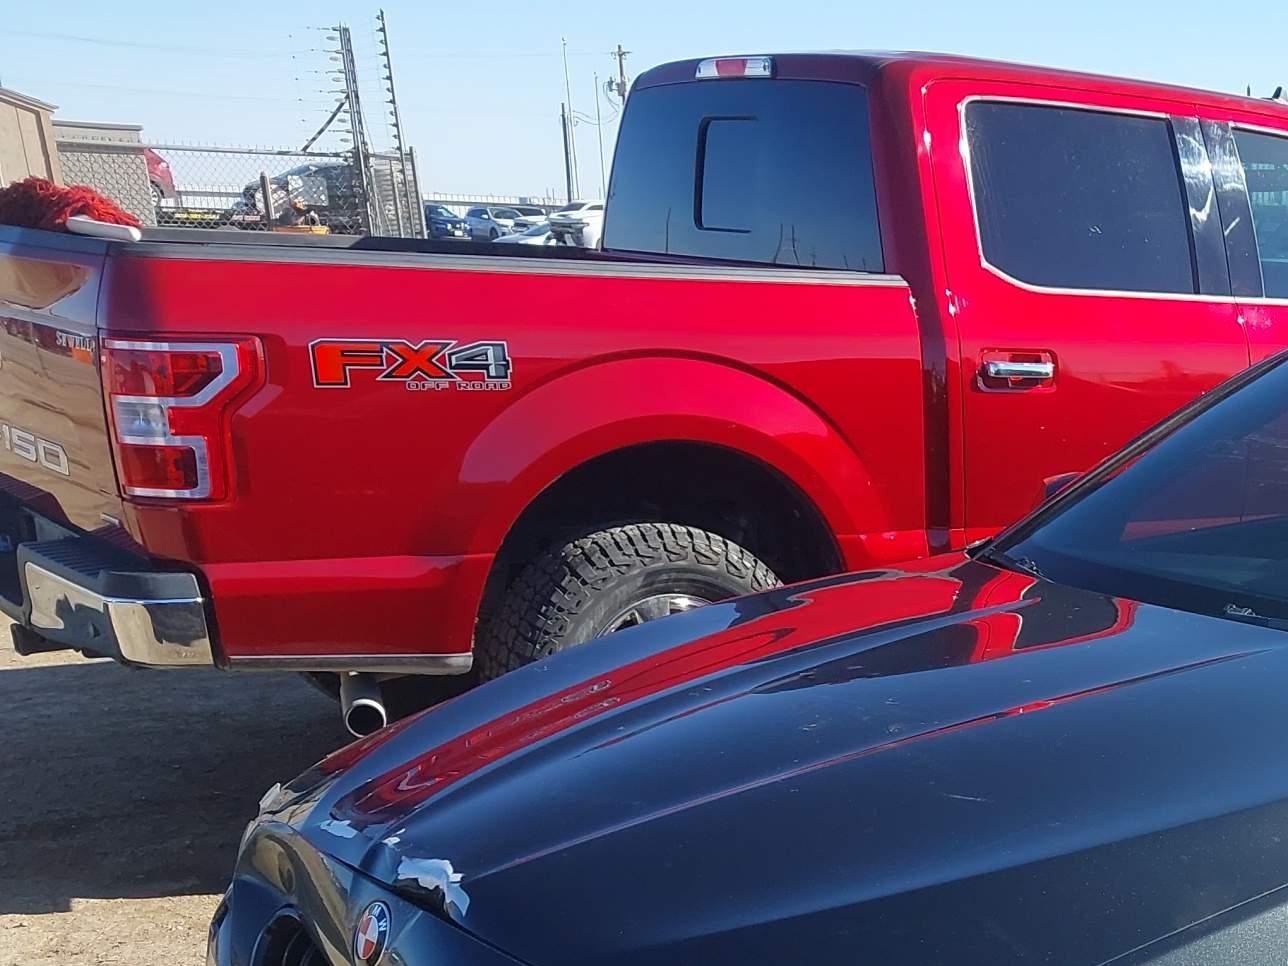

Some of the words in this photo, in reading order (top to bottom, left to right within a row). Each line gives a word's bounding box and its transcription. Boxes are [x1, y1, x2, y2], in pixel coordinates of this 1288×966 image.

[308, 338, 512, 388] FX4
[406, 381, 449, 391] OFF
[457, 381, 512, 391] ROAD
[0, 423, 70, 476] 150
